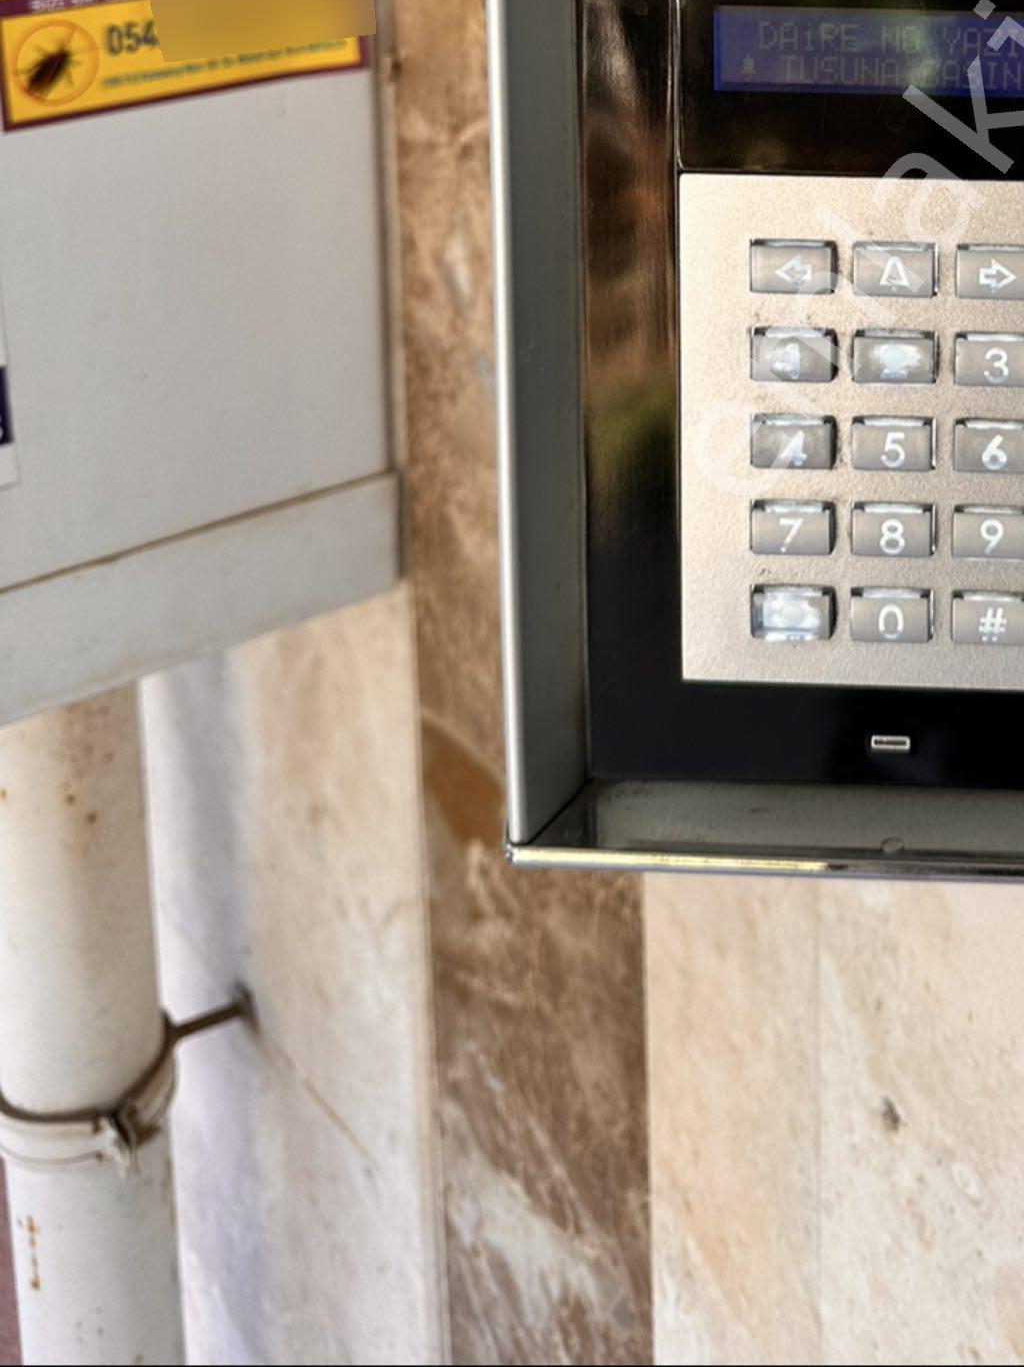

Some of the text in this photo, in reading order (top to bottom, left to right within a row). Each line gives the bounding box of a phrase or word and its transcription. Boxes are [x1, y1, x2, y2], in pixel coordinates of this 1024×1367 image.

[984, 347, 1009, 385] 3
[778, 430, 1008, 470] 4 5 6
[778, 518, 1005, 555] 7 8 9
[878, 604, 1007, 643] 0 #
